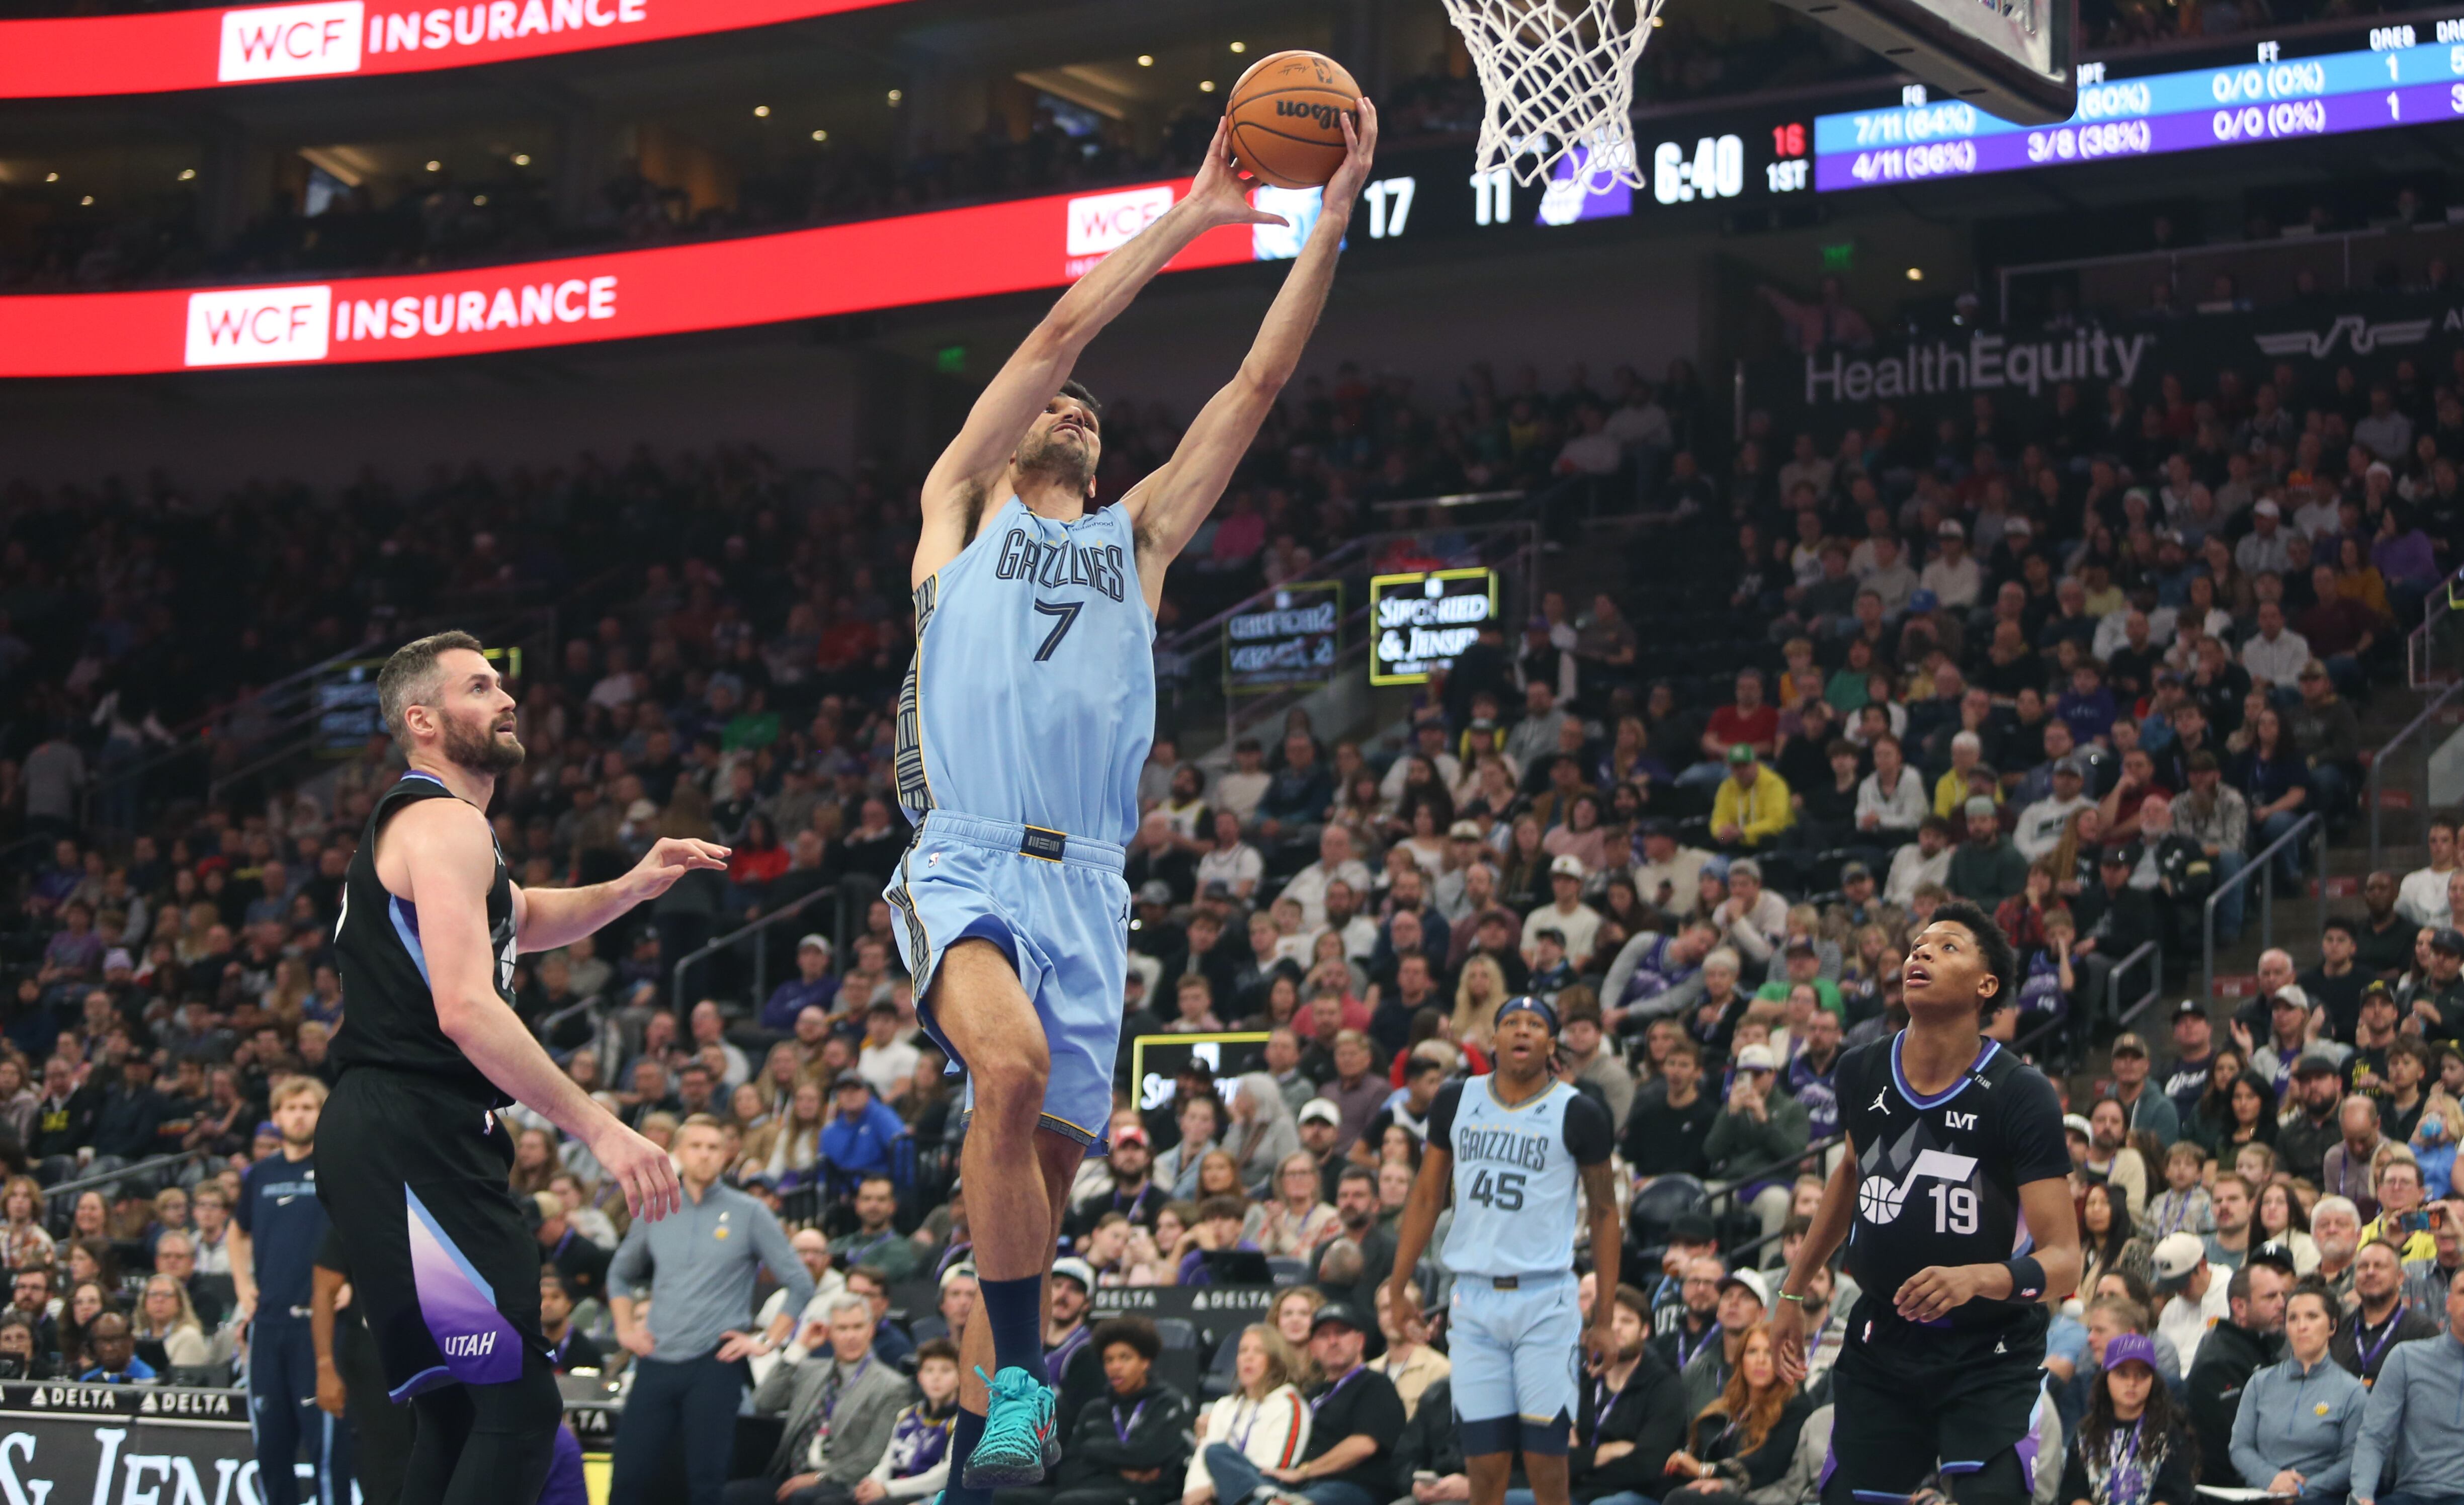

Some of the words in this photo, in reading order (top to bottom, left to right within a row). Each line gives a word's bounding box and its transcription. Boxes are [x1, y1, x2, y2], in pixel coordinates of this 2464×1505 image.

[238, 18, 347, 62] WCF
[368, 0, 647, 54] INSURANCE
[2369, 24, 2416, 52] OREB
[2436, 17, 2464, 43] DR
[2257, 41, 2280, 65] FT
[1853, 112, 1904, 145] 7/11
[1904, 104, 1977, 142] (64%)
[2213, 68, 2264, 103] 0/0
[2267, 61, 2325, 100] (0%)
[2386, 53, 2399, 82] 1
[2450, 45, 2464, 75] 5
[1773, 122, 1805, 157] 16
[1851, 148, 1904, 182] 4/11
[1904, 139, 1977, 179] (36%)
[2027, 131, 2077, 162] 3/8
[2078, 119, 2151, 159] (38%)
[2214, 106, 2264, 141] 0/0
[2267, 99, 2326, 138] (0%)
[2387, 91, 2400, 121] 1
[2451, 83, 2464, 114] 3
[1654, 134, 1743, 205] 6:40
[1766, 161, 1809, 192] 1ST
[1364, 176, 1415, 239] 17
[1470, 169, 1511, 225] 11
[1080, 201, 1160, 238] WCF
[205, 304, 313, 346] WCF
[335, 276, 618, 342] INSURANCE
[2442, 307, 2464, 332] A
[1805, 328, 2145, 403] HealthEquity
[996, 528, 1124, 603] GRZZLIES
[1034, 597, 1084, 661] 7
[1378, 629, 1405, 662] &
[1945, 1110, 1978, 1130] LVT
[1459, 1126, 1549, 1172] GRIZZLIES
[1469, 1169, 1526, 1212] 45
[1928, 1184, 1978, 1234] 19
[1094, 1290, 1156, 1307] DELTA
[1210, 1290, 1271, 1307] DELTA
[445, 1331, 497, 1357] UTAH
[51, 1387, 116, 1409] DELTA
[161, 1393, 230, 1414] DELTA
[563, 1408, 608, 1432] LTA
